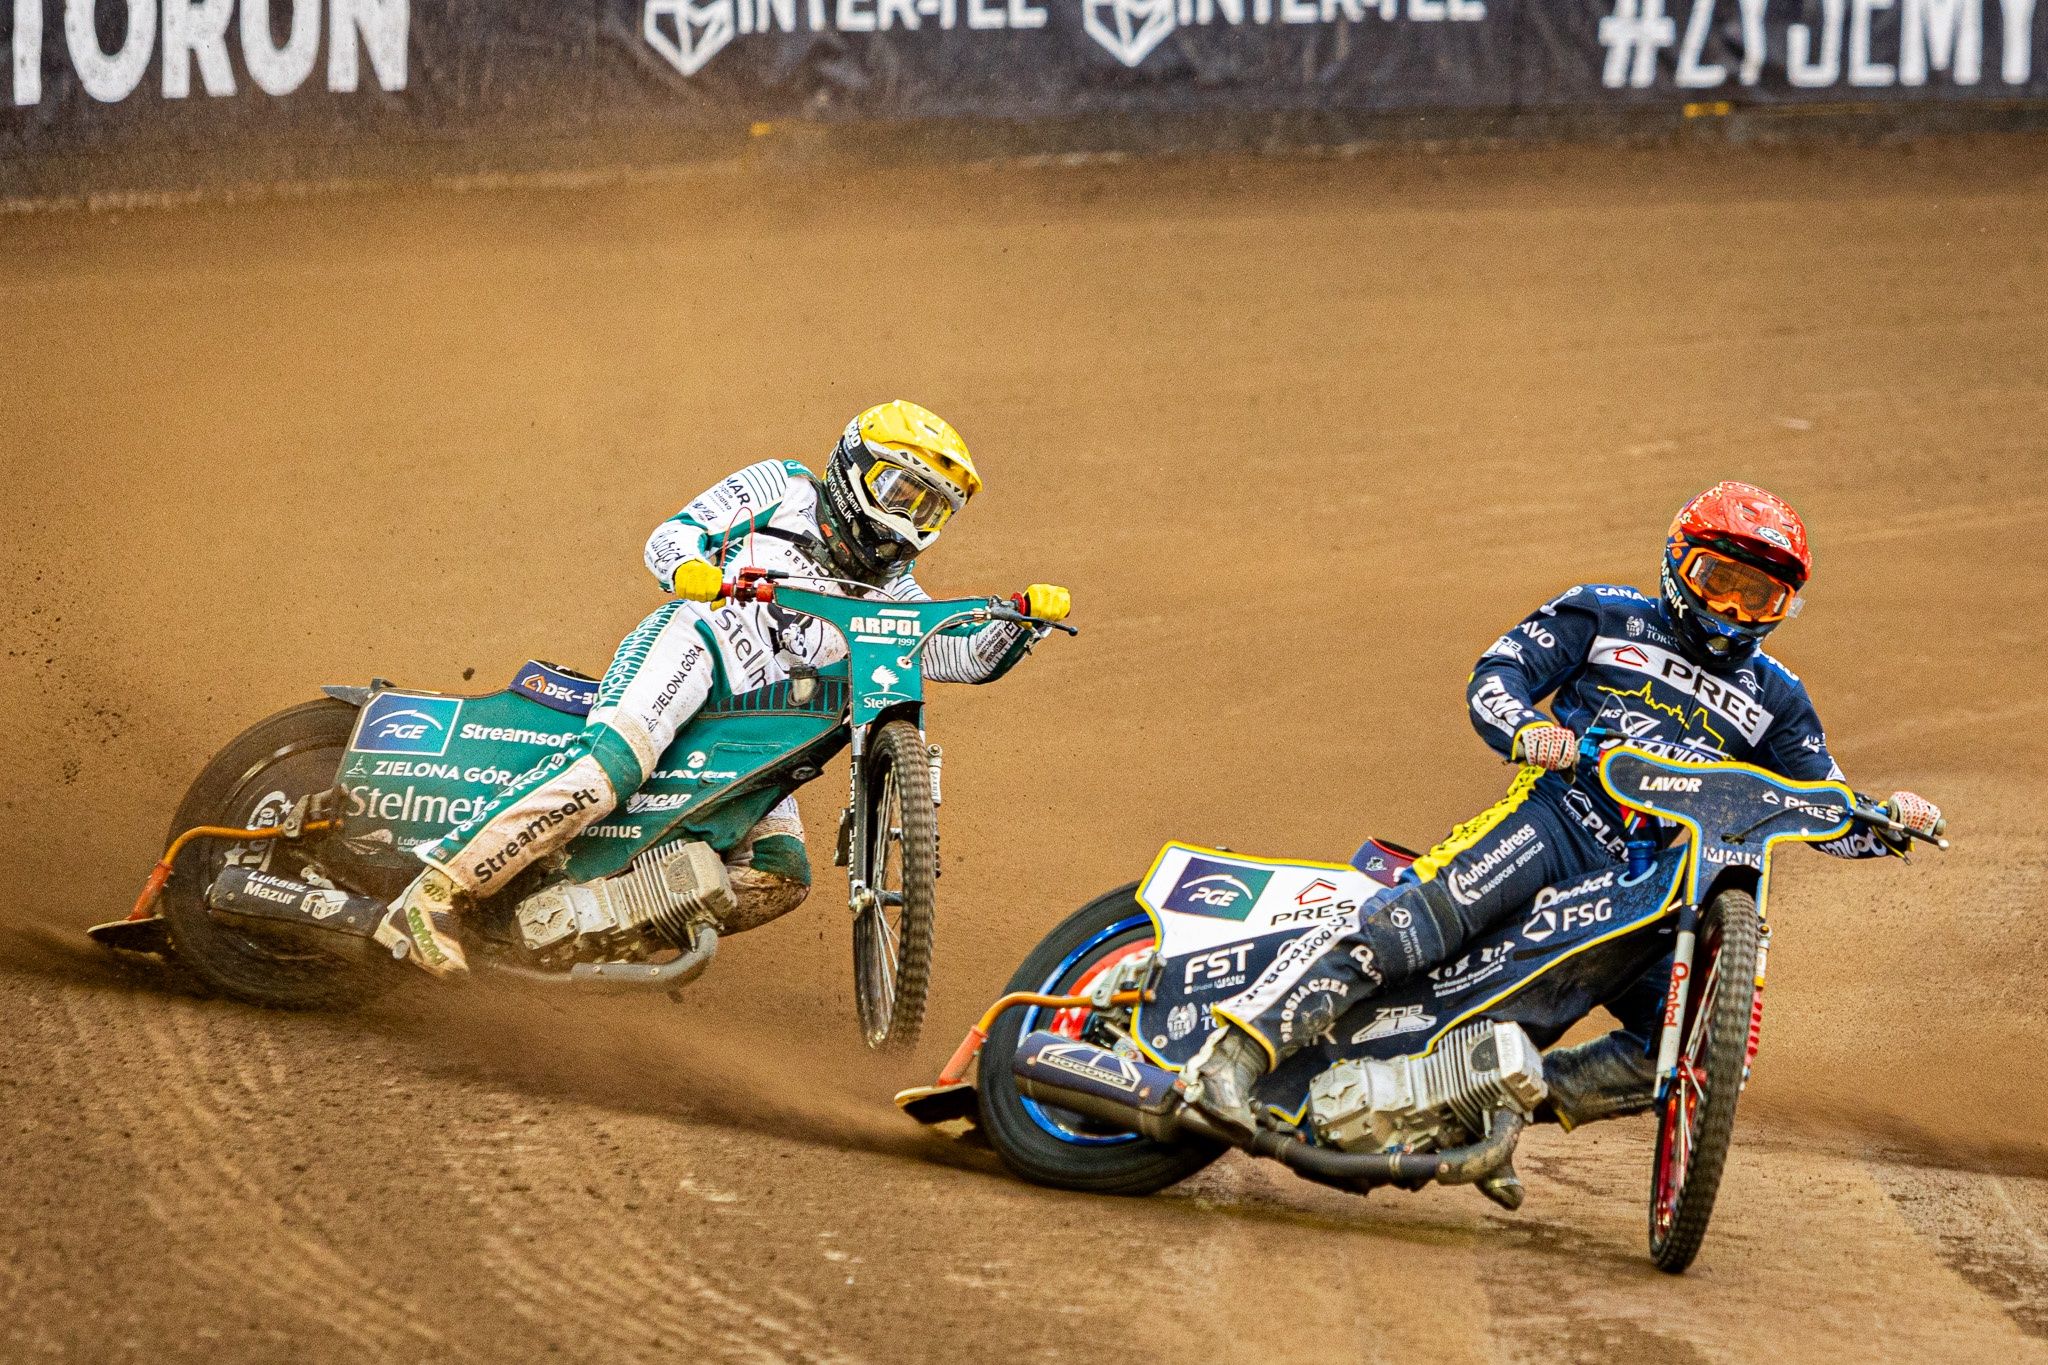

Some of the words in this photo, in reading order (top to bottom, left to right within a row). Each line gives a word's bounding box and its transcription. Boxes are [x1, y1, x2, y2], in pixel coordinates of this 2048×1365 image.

[834, 489, 855, 523] FRELIK
[849, 616, 924, 637] ARPOL
[896, 637, 916, 647] 1991
[651, 670, 687, 717] ZIELONA
[681, 644, 704, 675] GÓRA
[1661, 658, 1761, 734] PRES
[379, 723, 428, 740] PGE
[372, 760, 459, 780] ZIELONA
[1639, 775, 1702, 793] LAVOR
[346, 784, 487, 826] Stelmet
[1783, 794, 1842, 823] PRES
[474, 786, 602, 886] Streamsoft
[1457, 823, 1537, 889] AutoAndreas
[1480, 862, 1517, 896] TRANSPORT
[1514, 841, 1546, 868] SPEDYCJA
[243, 880, 297, 905] Mazur
[1188, 886, 1239, 907] PGE
[1270, 900, 1357, 926] PRES
[1562, 897, 1612, 932] FSG
[1184, 942, 1255, 985] FST
[1047, 1054, 1128, 1087] ROGOWO
